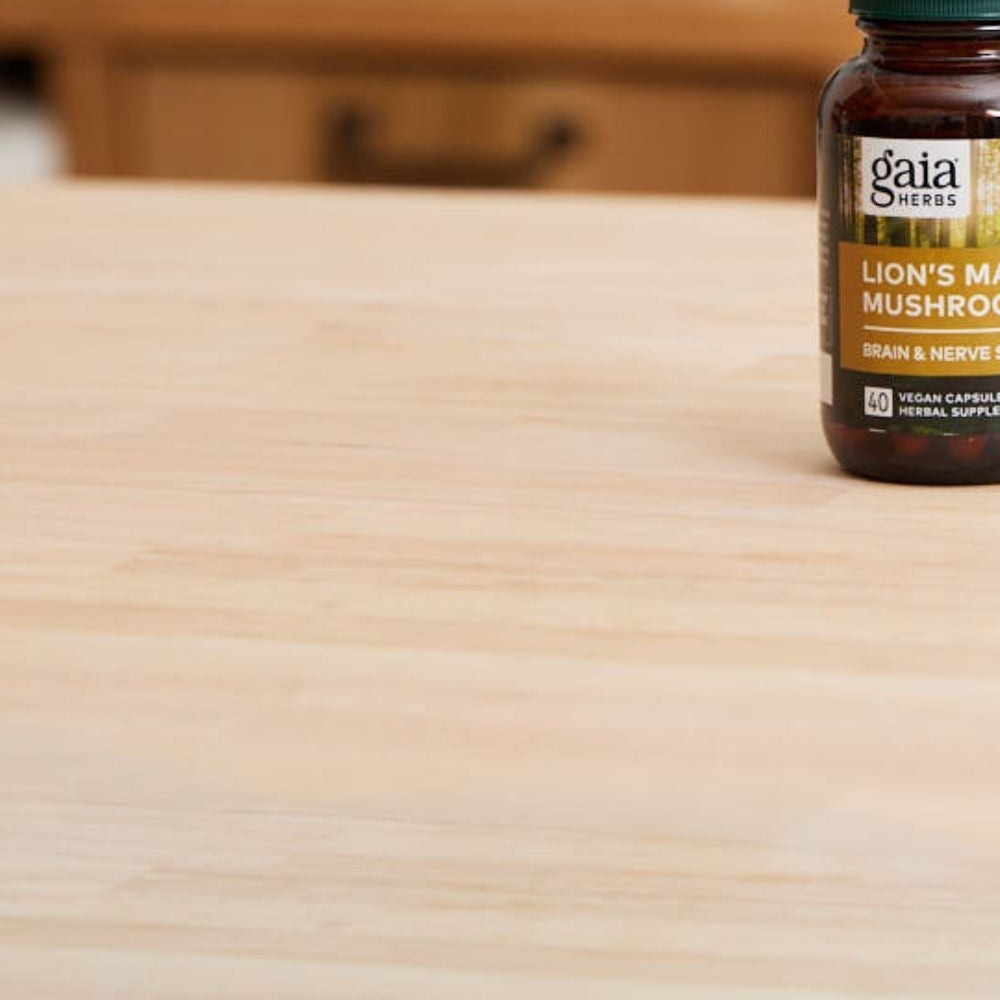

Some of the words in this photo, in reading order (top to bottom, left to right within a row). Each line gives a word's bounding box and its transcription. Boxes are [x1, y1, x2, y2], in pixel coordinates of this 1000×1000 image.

[871, 149, 960, 208] gaia
[899, 193, 957, 207] HERBS
[862, 259, 955, 287] LION'S
[862, 342, 910, 361] BRAIN
[914, 346, 925, 361] &
[930, 345, 991, 362] NERVE
[867, 391, 889, 413] 40
[898, 391, 941, 404] VEGAN
[898, 406, 948, 418] HERBAL
